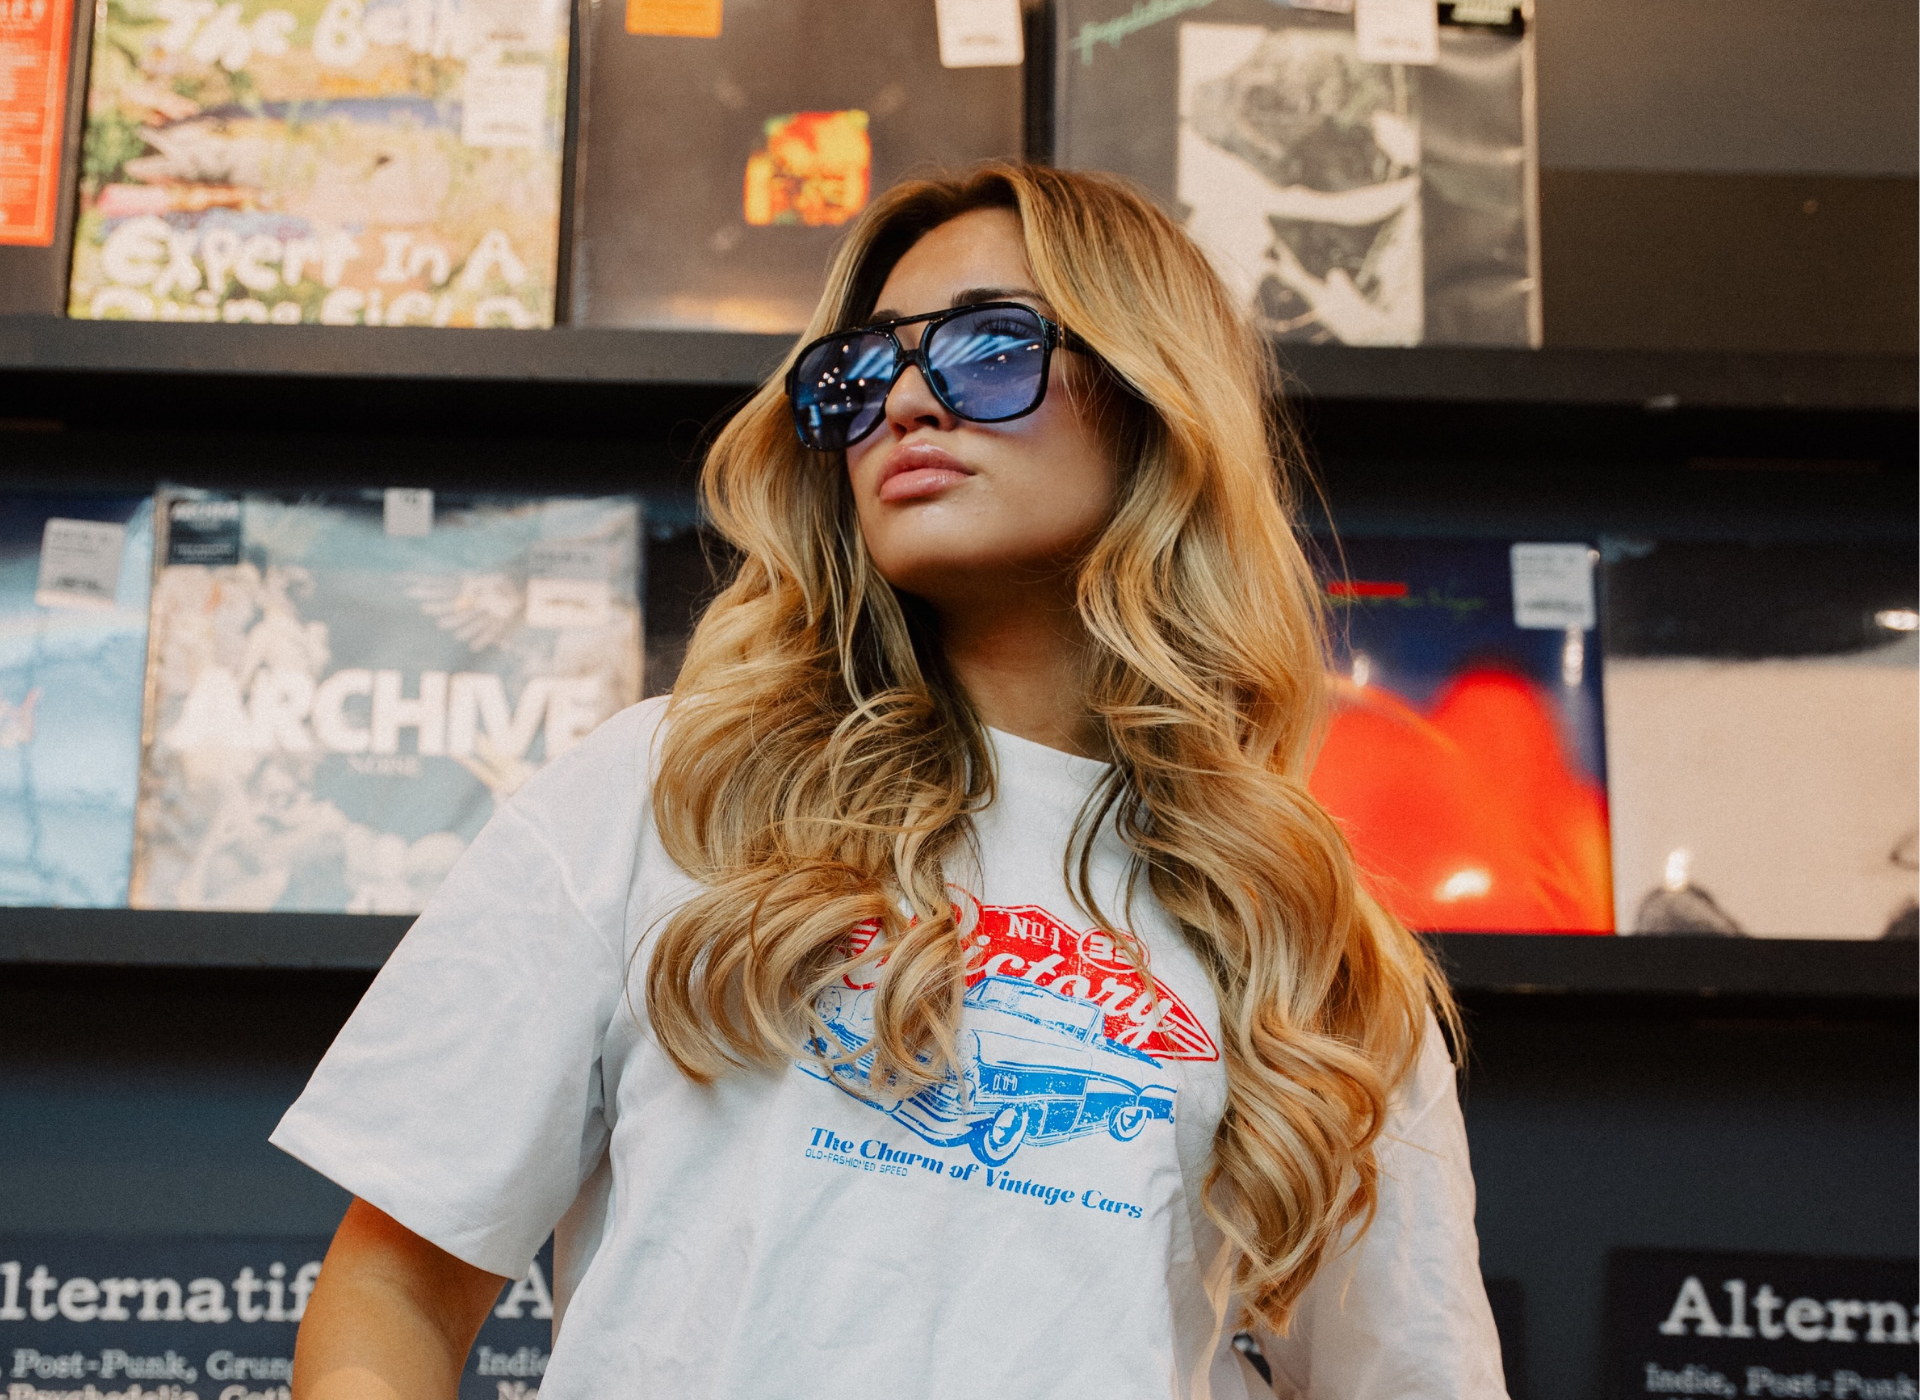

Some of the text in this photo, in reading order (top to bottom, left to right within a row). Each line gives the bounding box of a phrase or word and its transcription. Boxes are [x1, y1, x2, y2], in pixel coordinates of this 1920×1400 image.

[102, 215, 528, 297] Expert In A
[164, 668, 602, 760] ARCHIVE
[811, 1127, 1143, 1219] The Charm of Vintage Cars
[879, 1164, 909, 1177] SPEED
[0, 1260, 323, 1323] lternatif
[1658, 1275, 1919, 1344] Altern
[10, 1348, 199, 1384] Post-Punk,
